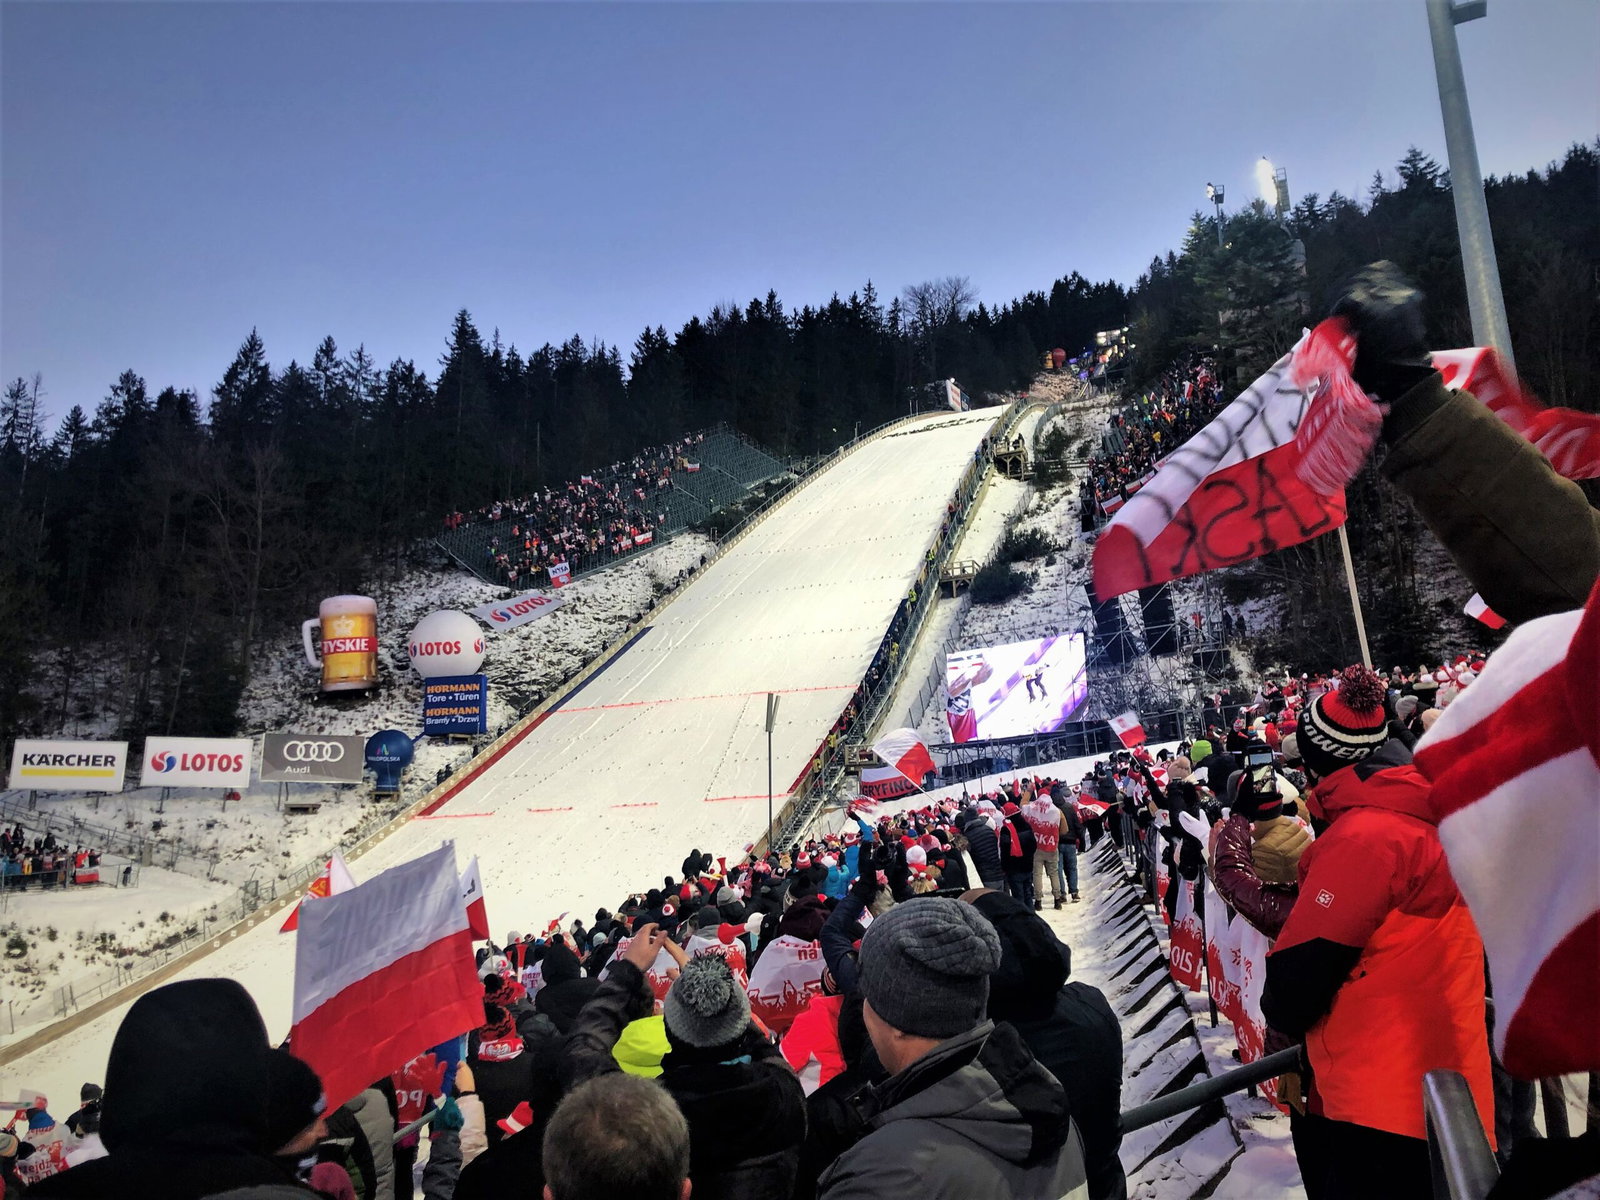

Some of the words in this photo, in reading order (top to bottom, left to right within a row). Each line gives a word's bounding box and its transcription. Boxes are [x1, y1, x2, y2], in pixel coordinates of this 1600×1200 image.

[506, 596, 553, 616] LOTOS
[323, 638, 369, 654] TYSKIE
[419, 641, 461, 656] LOTOS
[427, 694, 447, 703] Tore
[454, 692, 480, 701] Türen
[22, 753, 116, 768] KÄRCHER
[180, 753, 244, 773] LOTOS
[284, 765, 311, 774] Audi
